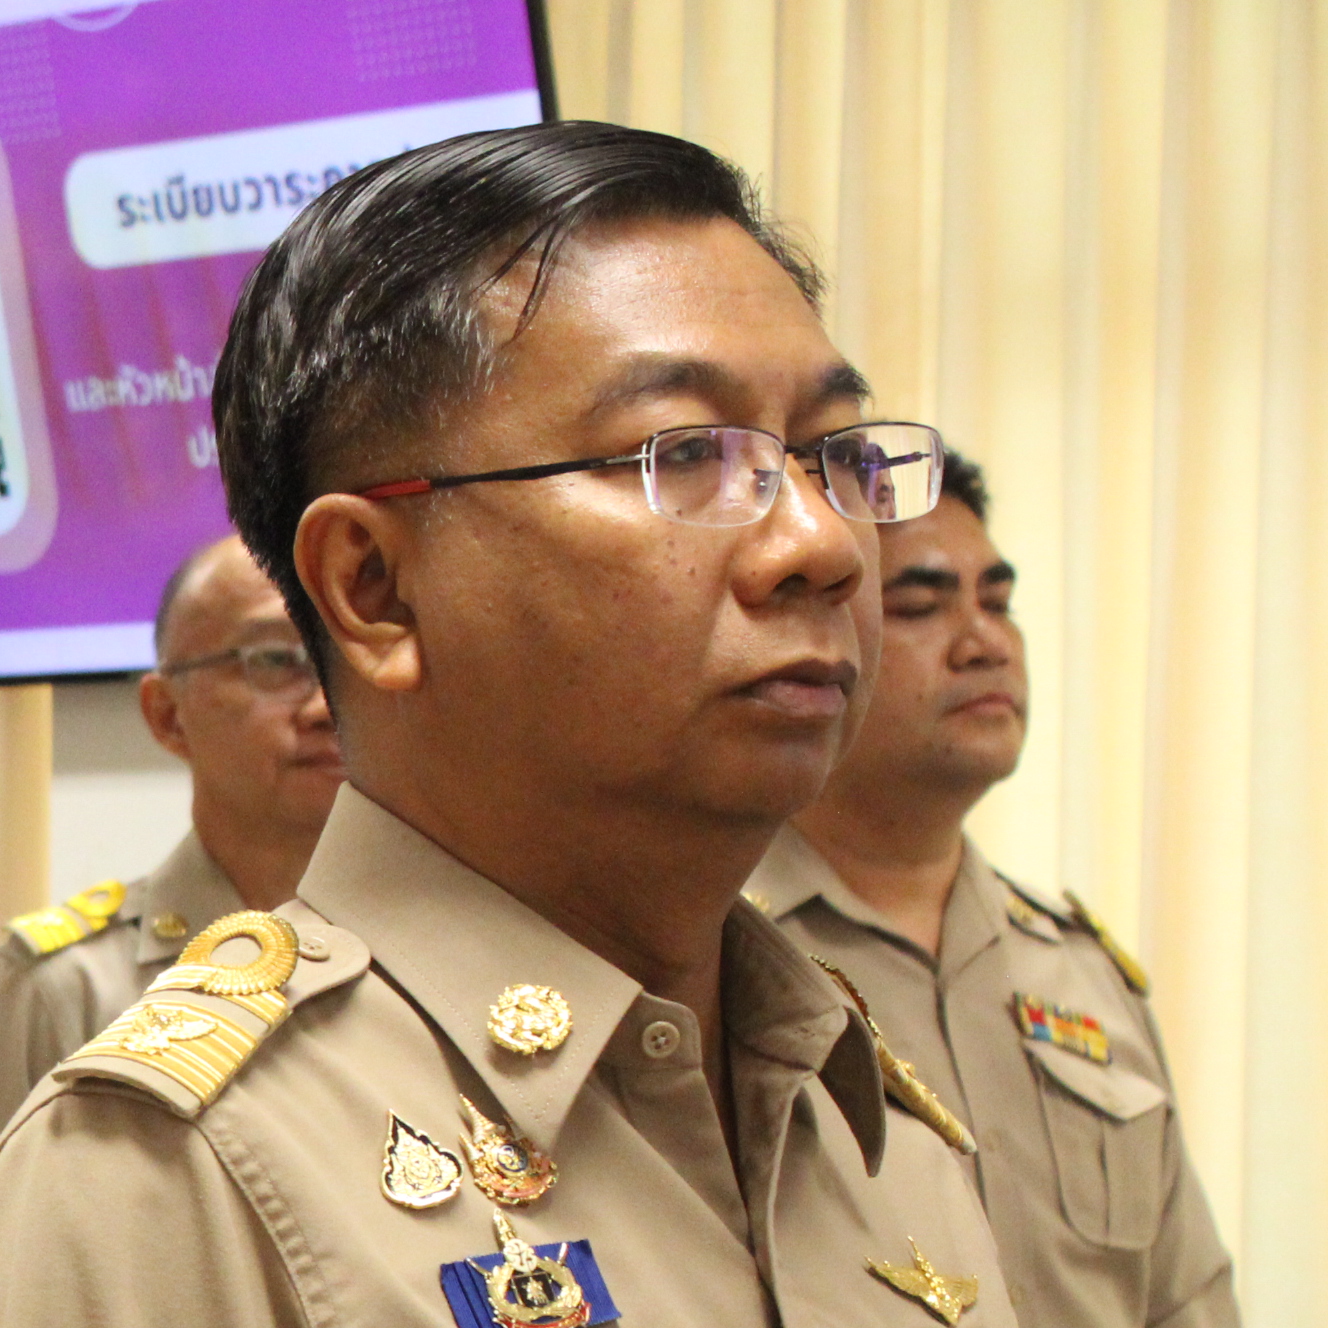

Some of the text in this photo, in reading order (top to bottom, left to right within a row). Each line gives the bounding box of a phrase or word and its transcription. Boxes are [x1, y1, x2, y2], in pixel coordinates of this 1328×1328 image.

[115, 160, 356, 228] ระเบียบวาระก
[63, 355, 216, 413] และหัวหน้า
